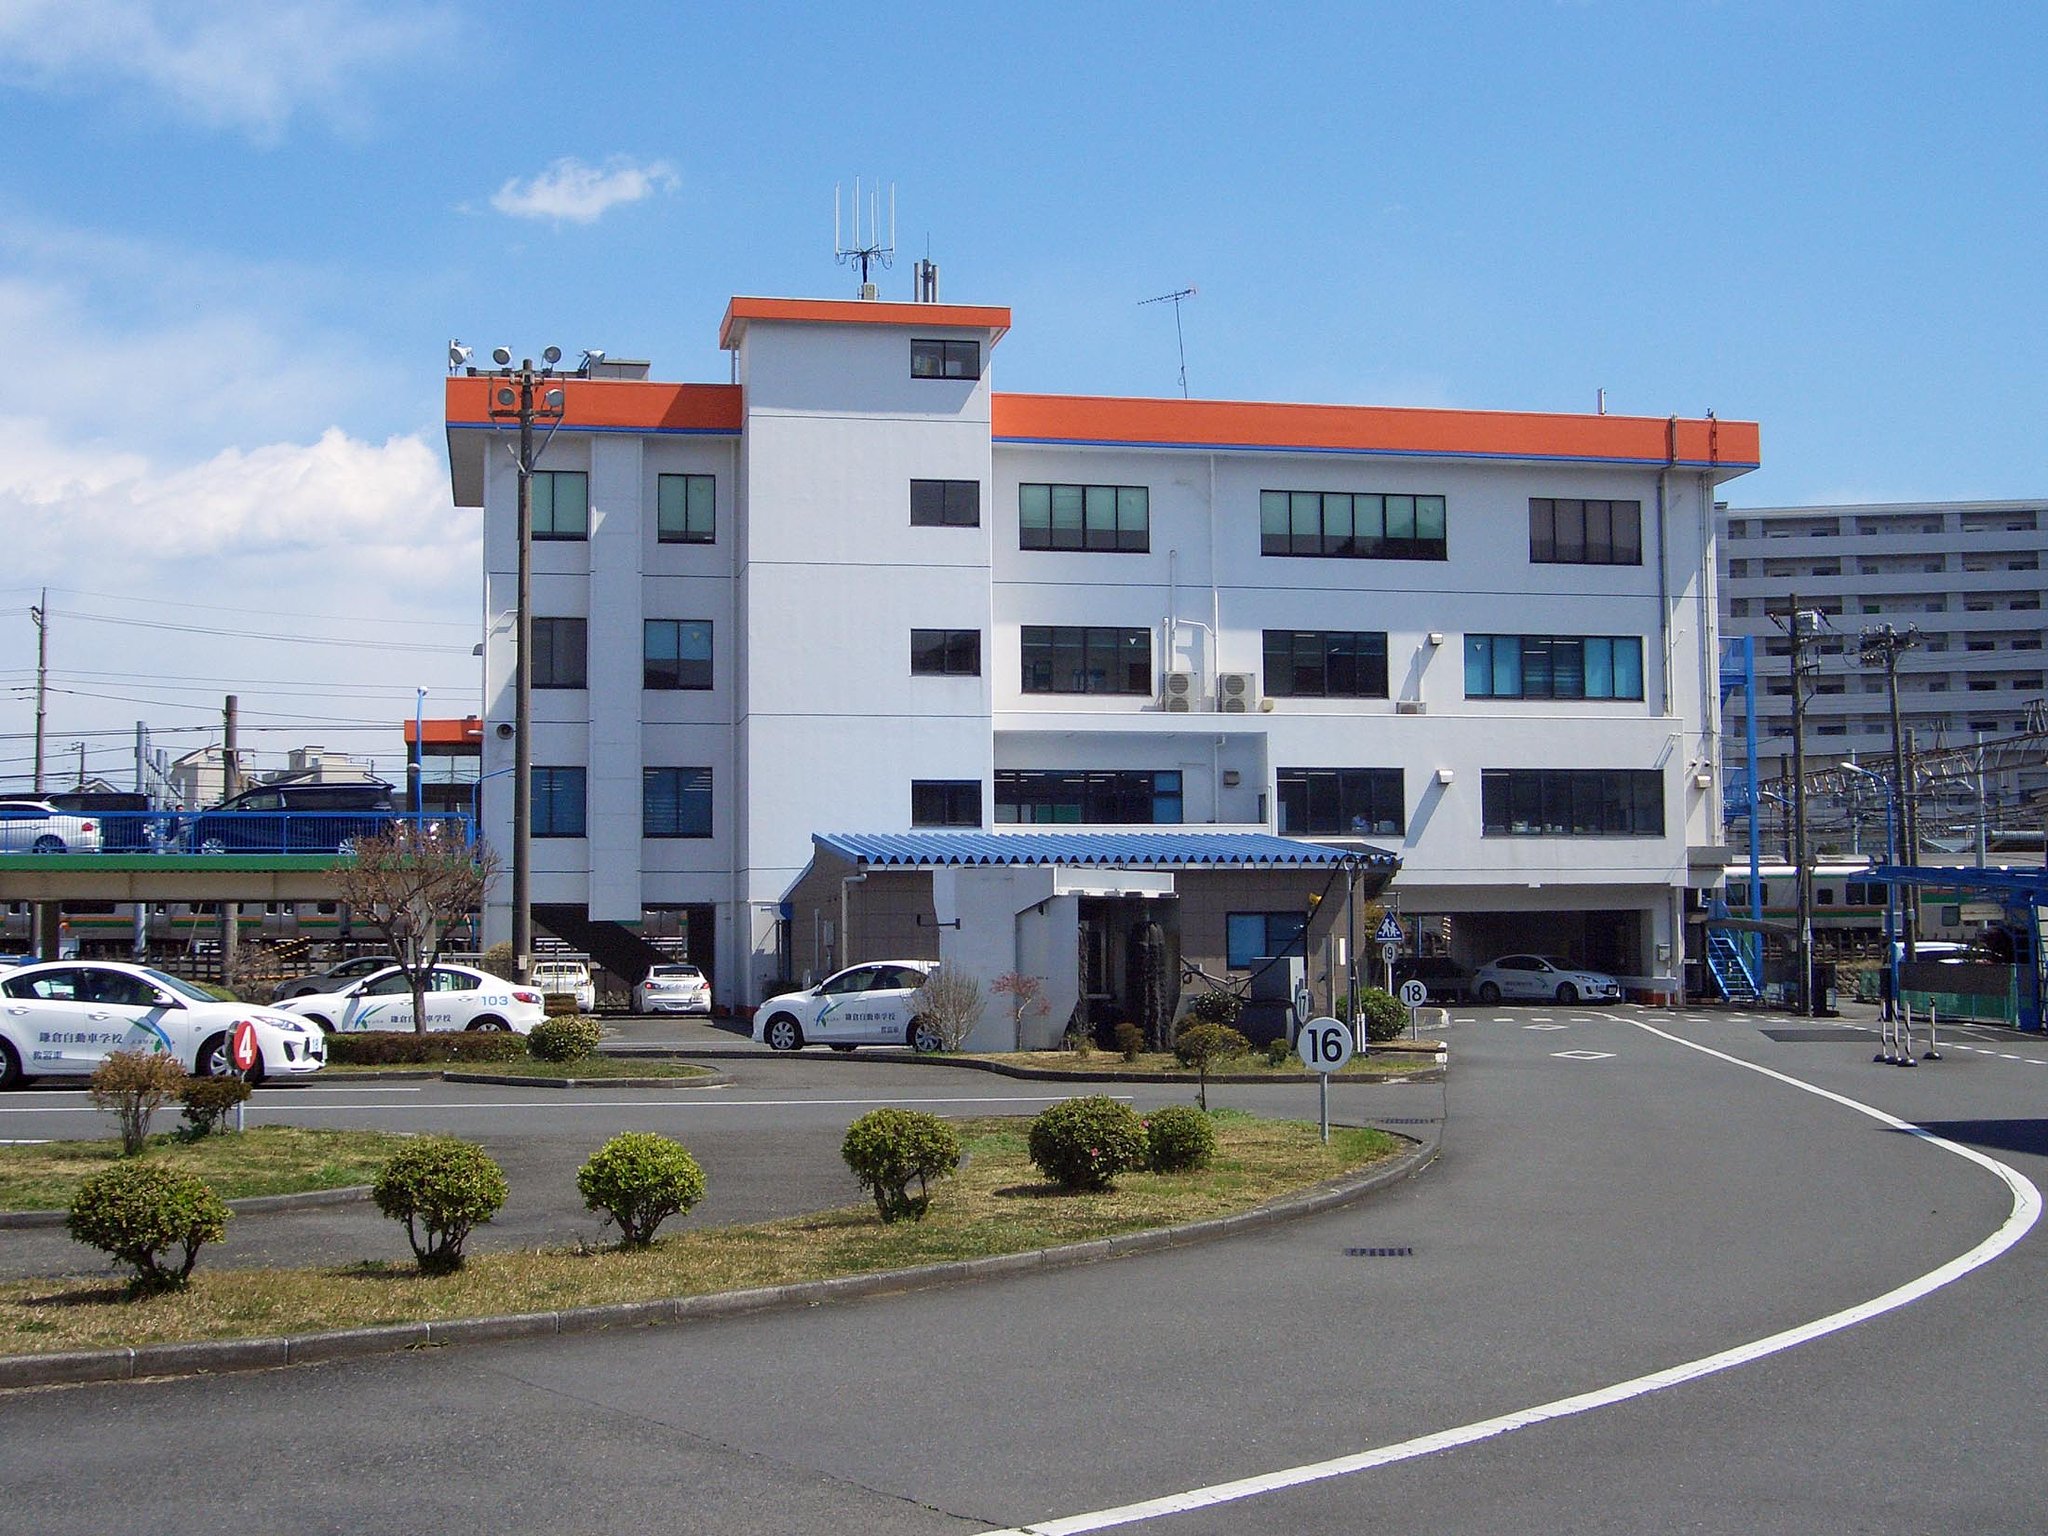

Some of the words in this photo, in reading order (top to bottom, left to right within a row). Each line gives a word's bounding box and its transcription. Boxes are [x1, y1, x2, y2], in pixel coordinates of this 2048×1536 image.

[1384, 946, 1393, 960] 19
[481, 996, 509, 1006] 103
[1405, 985, 1422, 1002] 18
[1298, 995, 1306, 1017] 17
[390, 1014, 452, 1023] 鎌倉自車学校
[39, 1032, 123, 1044] 鎌倉自動車学校
[238, 1025, 253, 1065] 4
[1308, 1028, 1343, 1063] 16
